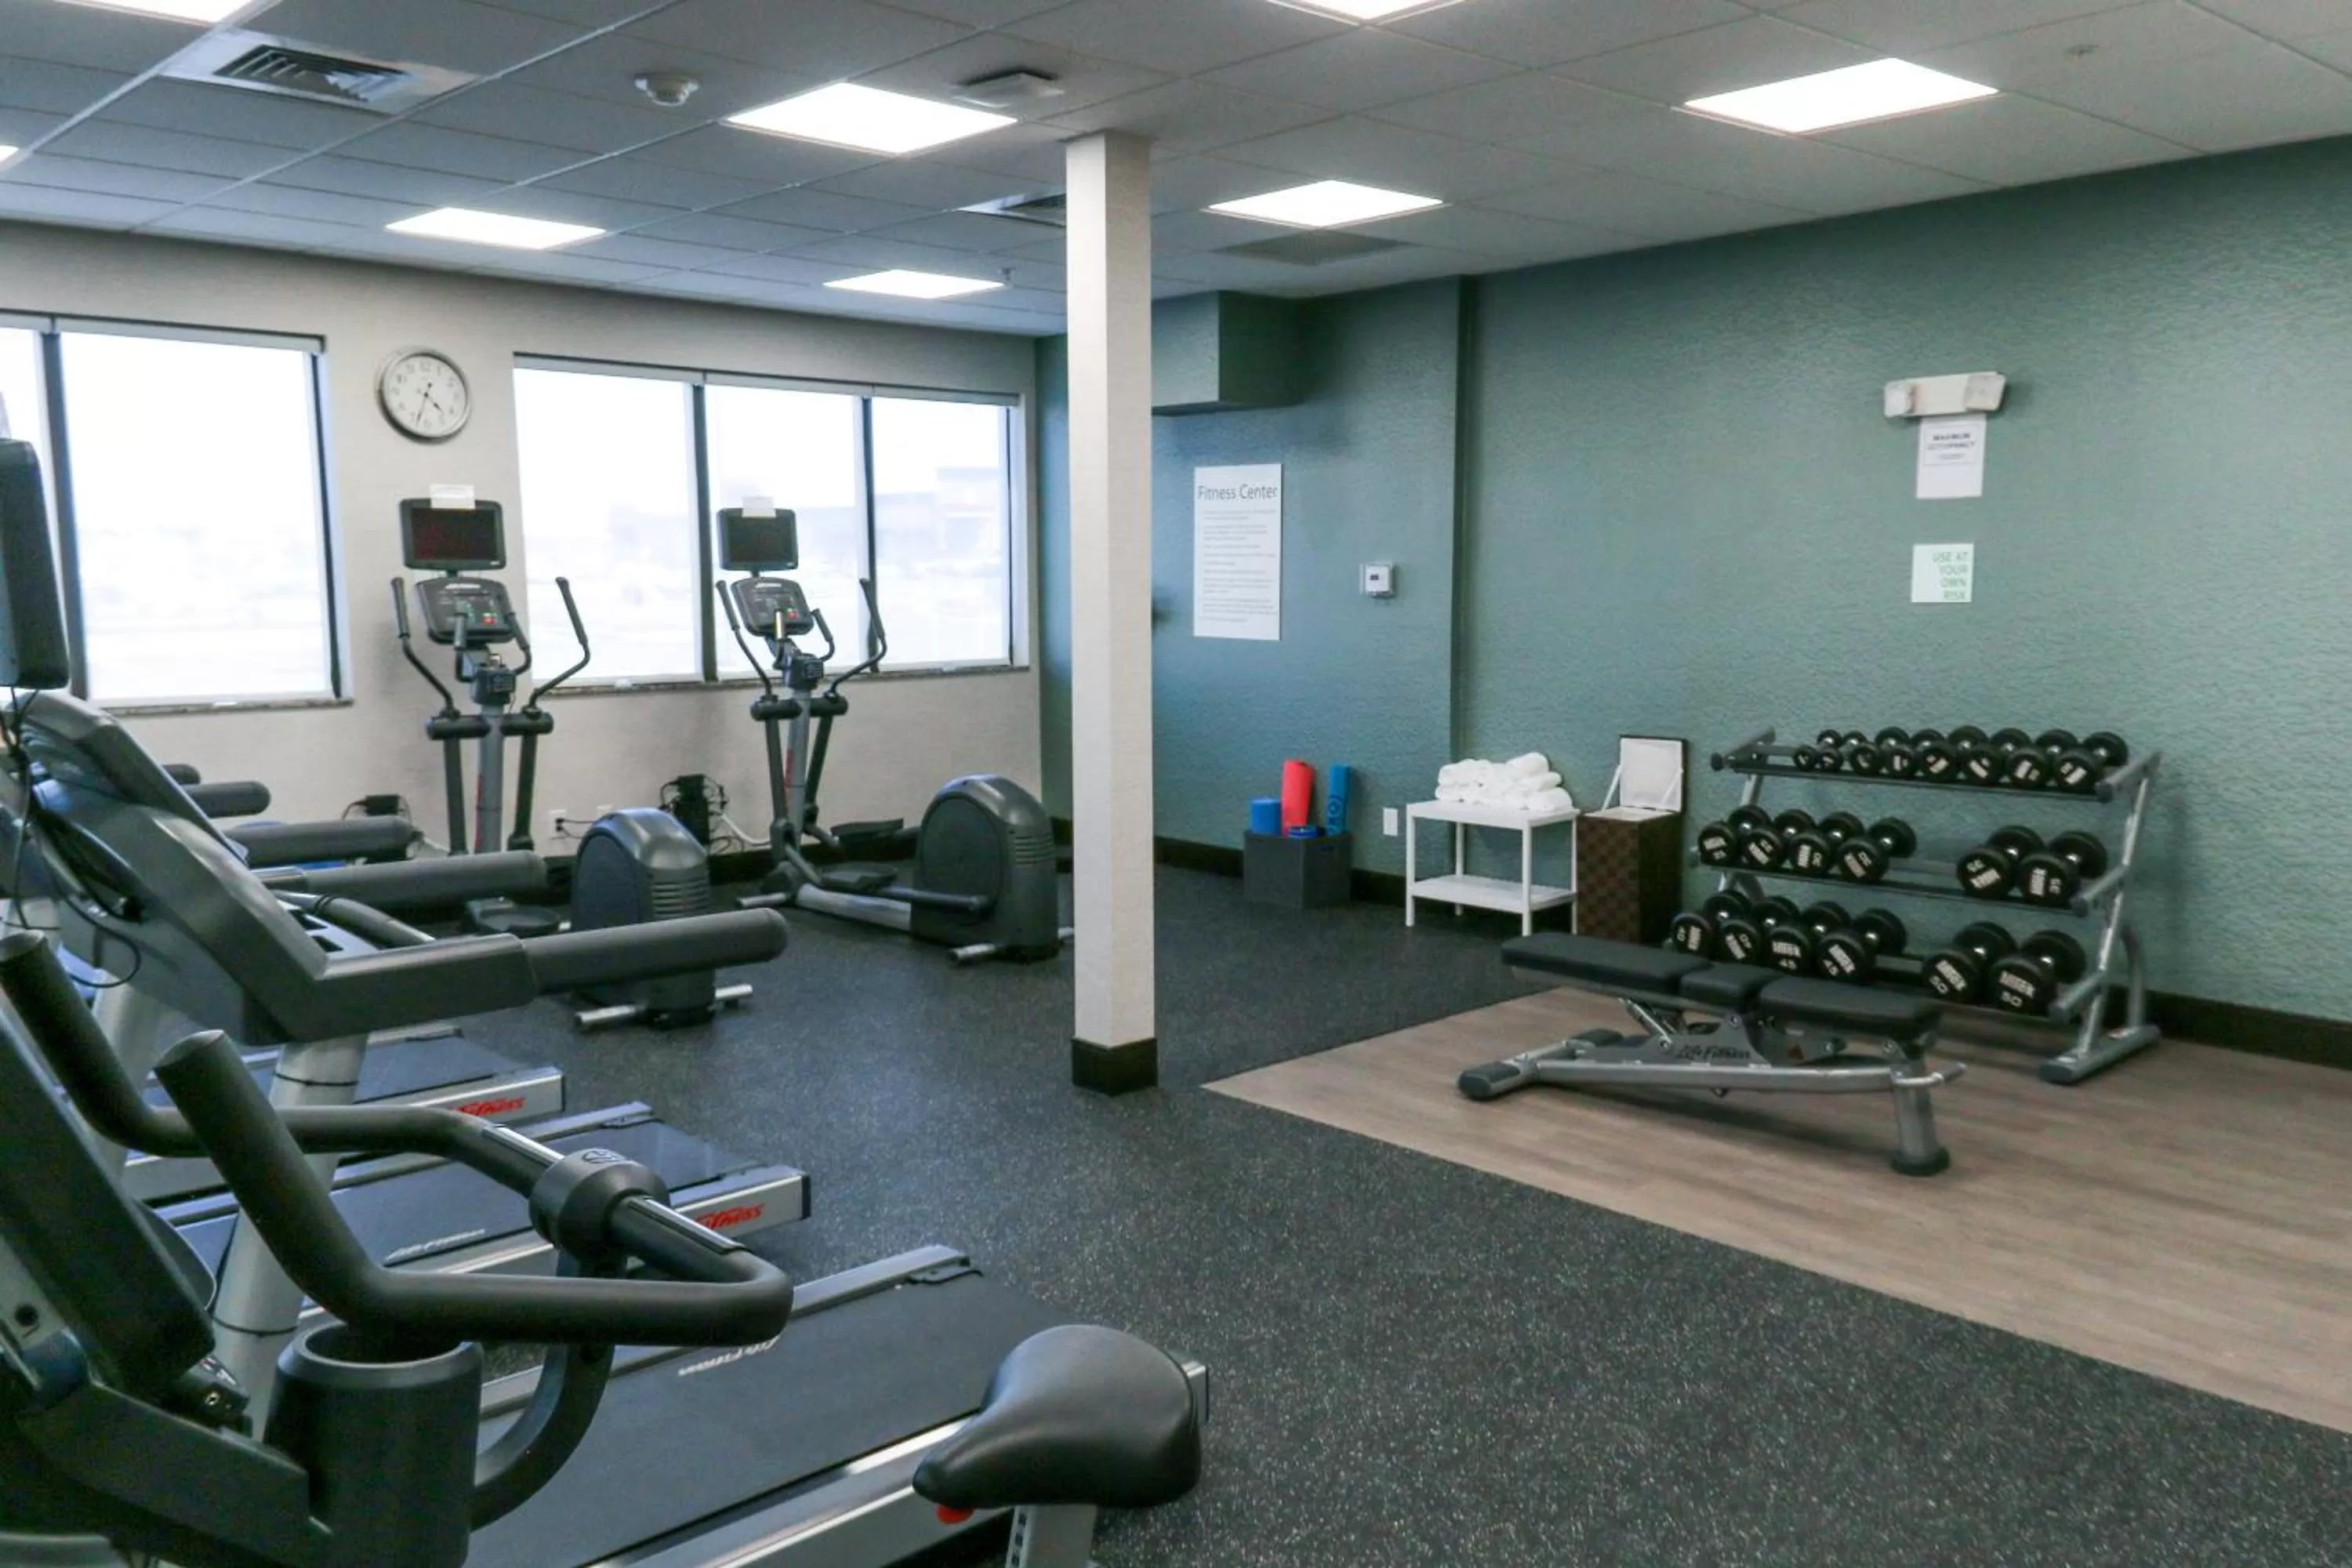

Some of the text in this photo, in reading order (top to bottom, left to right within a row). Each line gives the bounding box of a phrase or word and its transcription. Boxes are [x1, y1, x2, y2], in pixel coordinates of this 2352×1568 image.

[1197, 483, 1279, 500] Fitness Center
[1932, 551, 1951, 562] USE
[1938, 564, 1967, 575] YOUR
[2002, 990, 2023, 1007] 50
